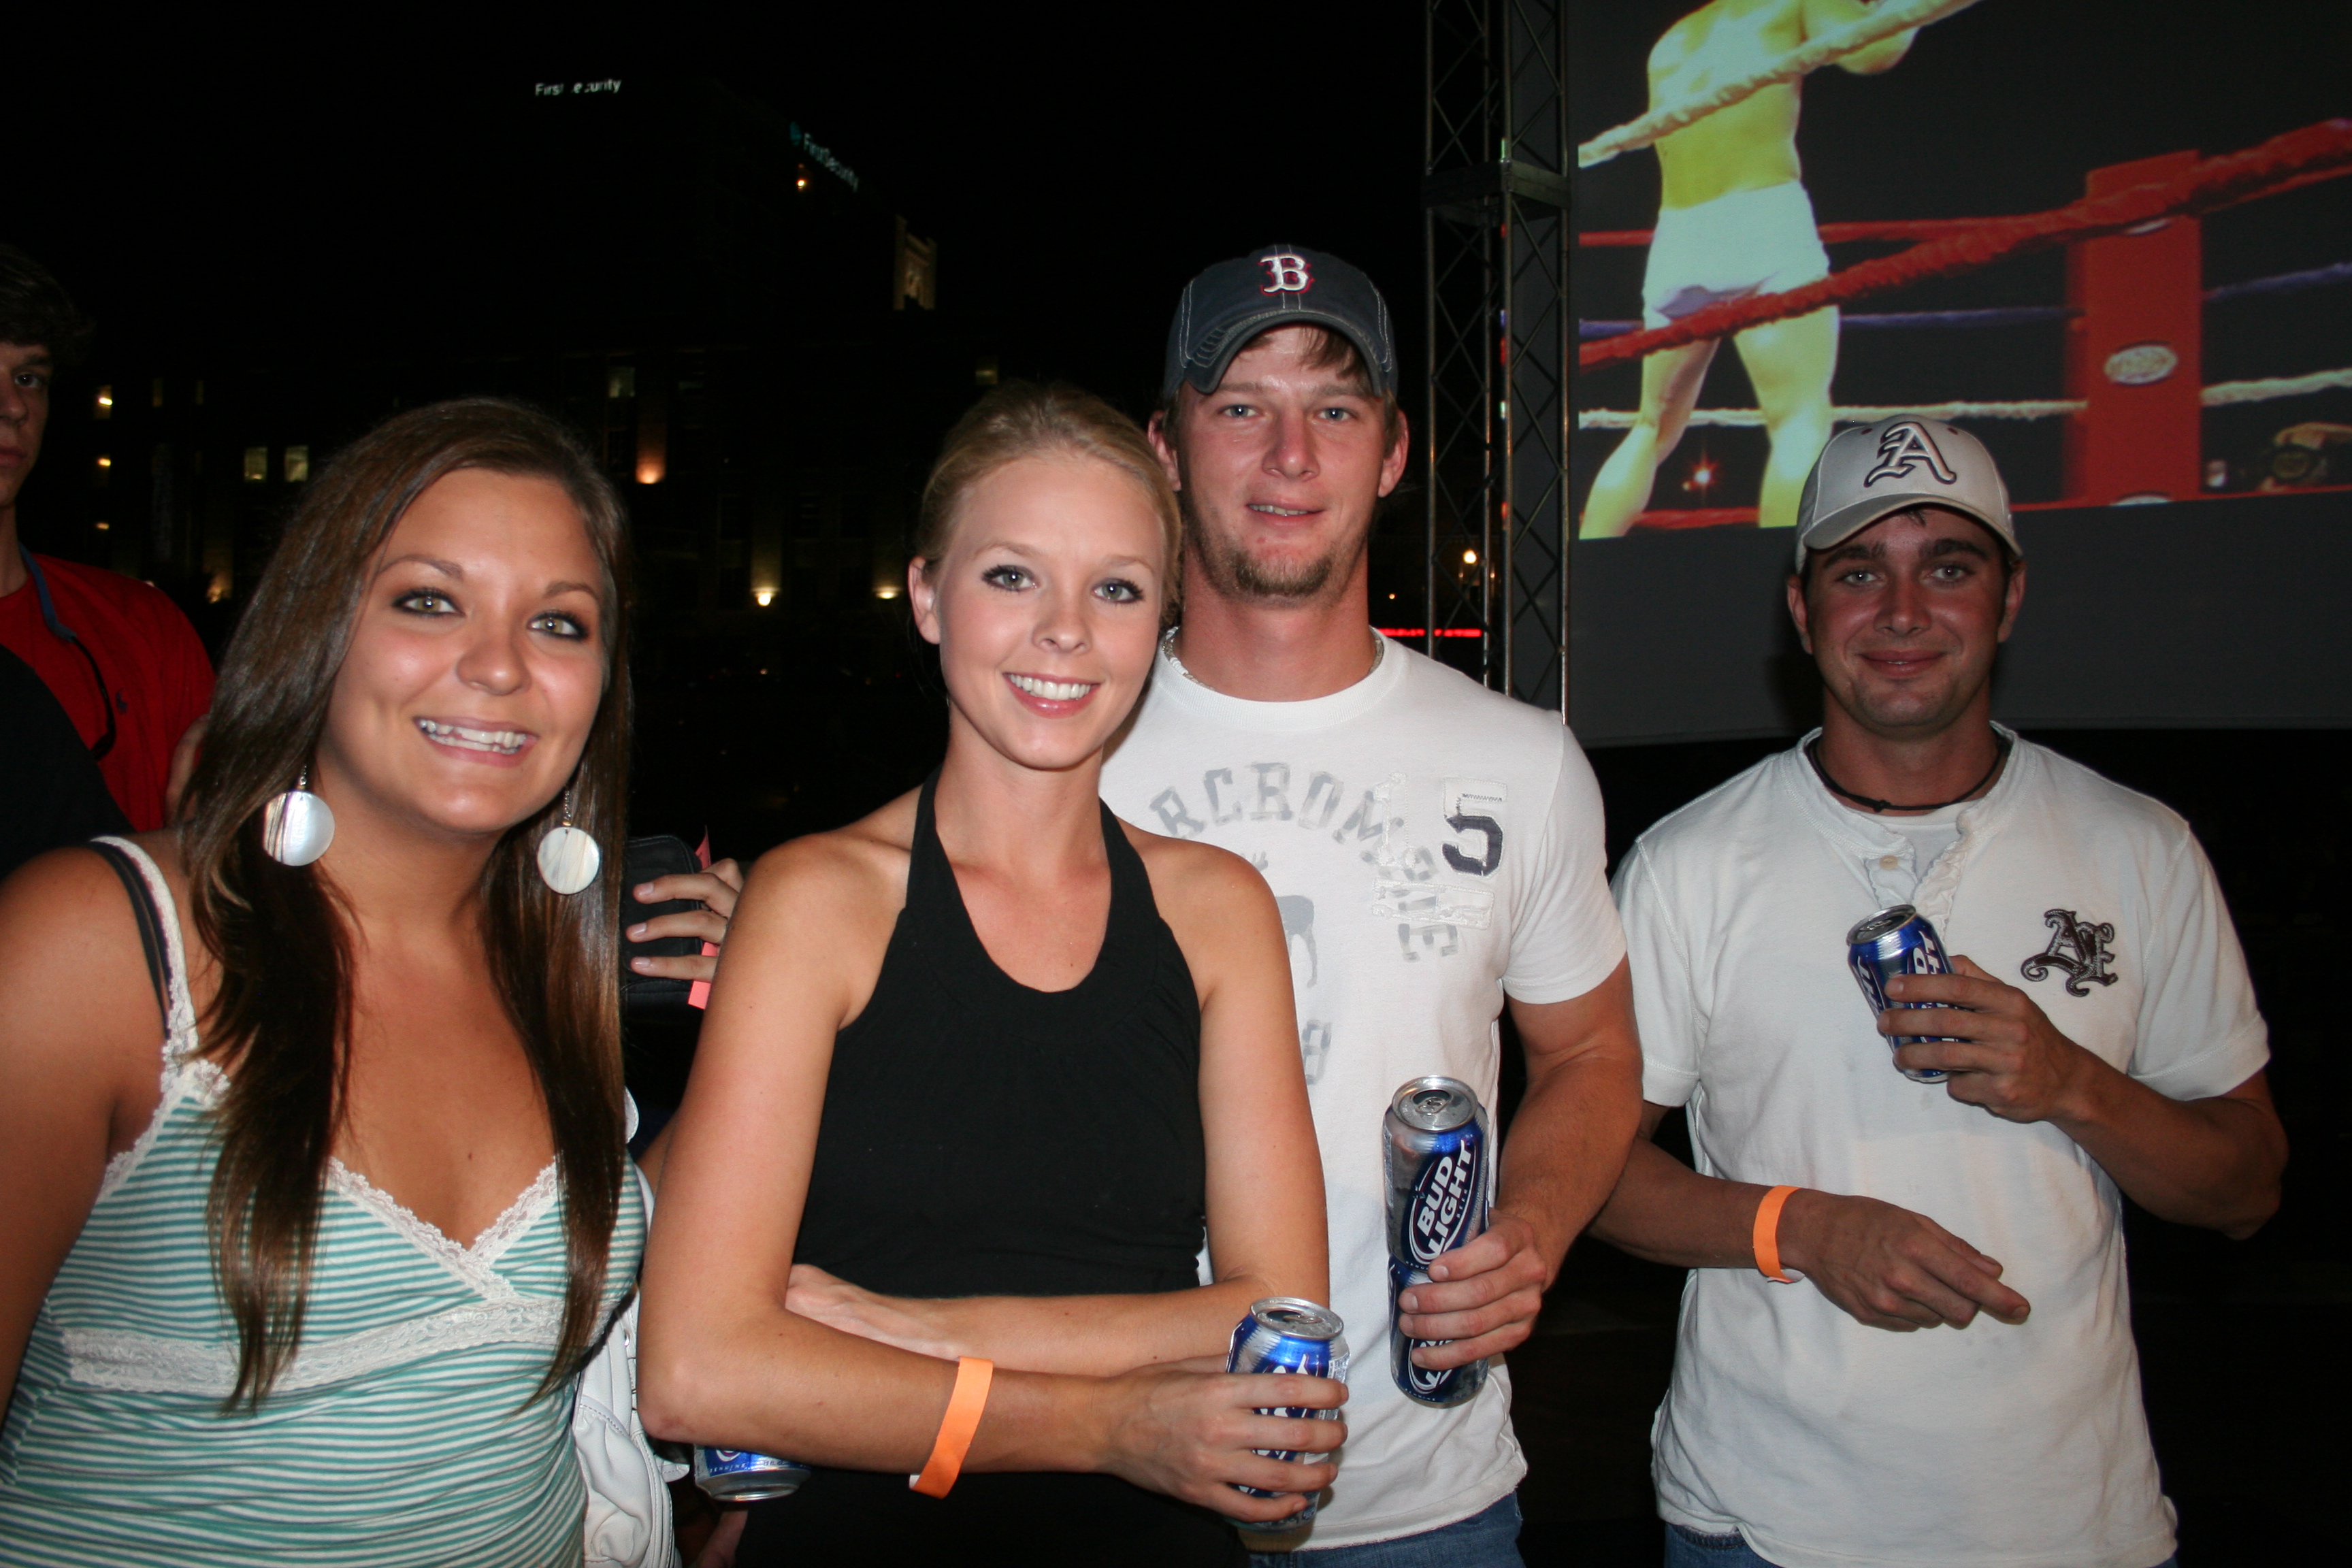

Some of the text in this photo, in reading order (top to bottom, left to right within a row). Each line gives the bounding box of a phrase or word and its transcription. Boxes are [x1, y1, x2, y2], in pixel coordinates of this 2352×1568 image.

[1258, 253, 1315, 295] B
[1863, 421, 1957, 488] A
[1417, 1156, 1454, 1237] BUD
[1428, 1139, 1472, 1257] LIGHT
